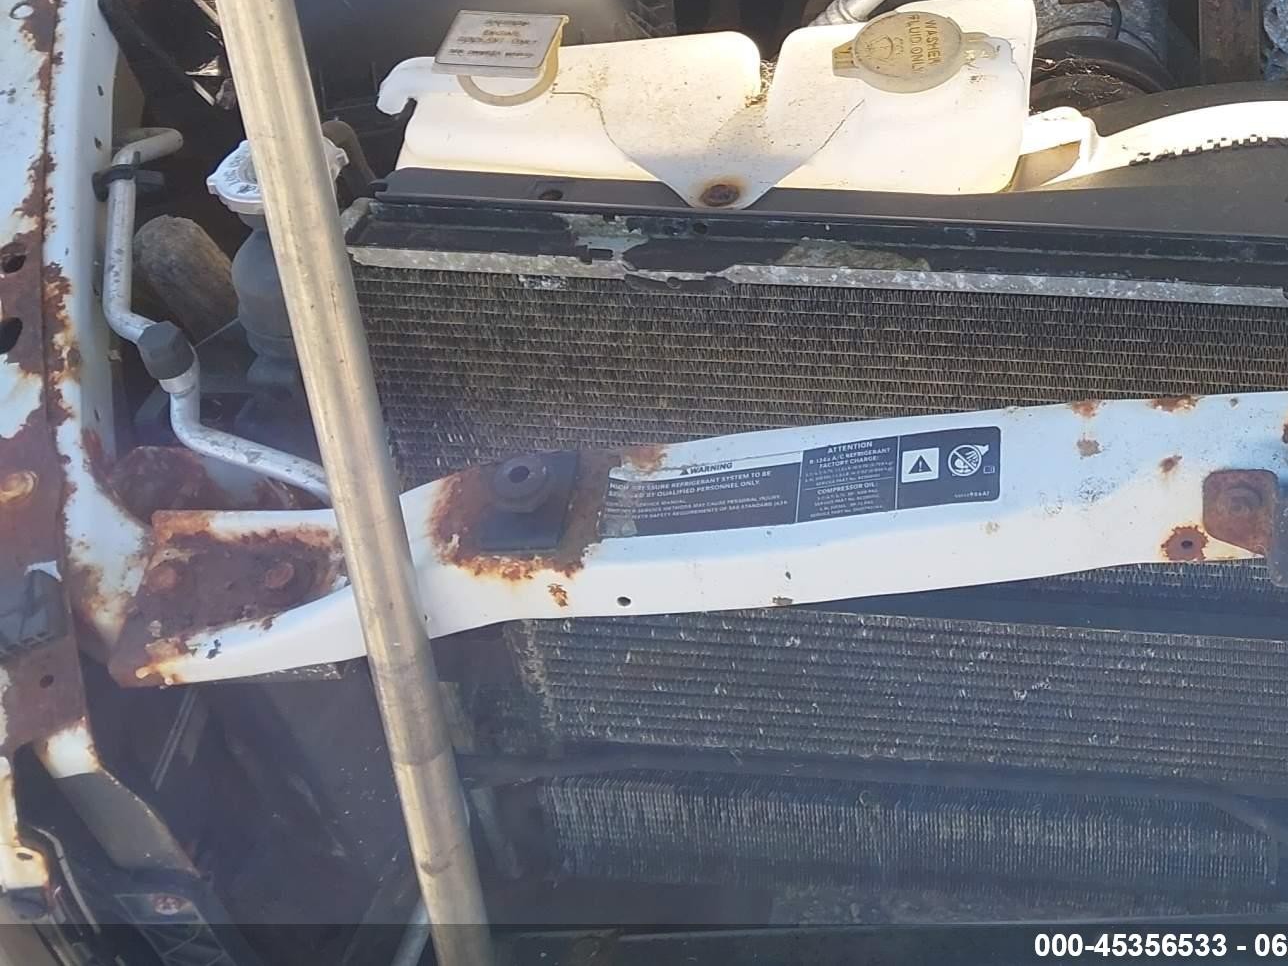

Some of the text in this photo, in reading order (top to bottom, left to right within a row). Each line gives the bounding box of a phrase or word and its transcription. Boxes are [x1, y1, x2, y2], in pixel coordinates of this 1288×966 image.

[906, 14, 926, 74] FLUID ONLY
[925, 19, 941, 65] WASHER
[827, 441, 873, 453] ATTENTION
[845, 447, 891, 459] REFRIGERANT
[690, 462, 733, 474] WARNING
[671, 476, 720, 489] REFRIGERANT
[721, 472, 750, 483] SYSTEM
[751, 471, 761, 479] TO
[656, 486, 695, 498] QUALIFIED
[696, 481, 740, 493] PERSONNEL
[816, 483, 863, 496] COMPRESSOR
